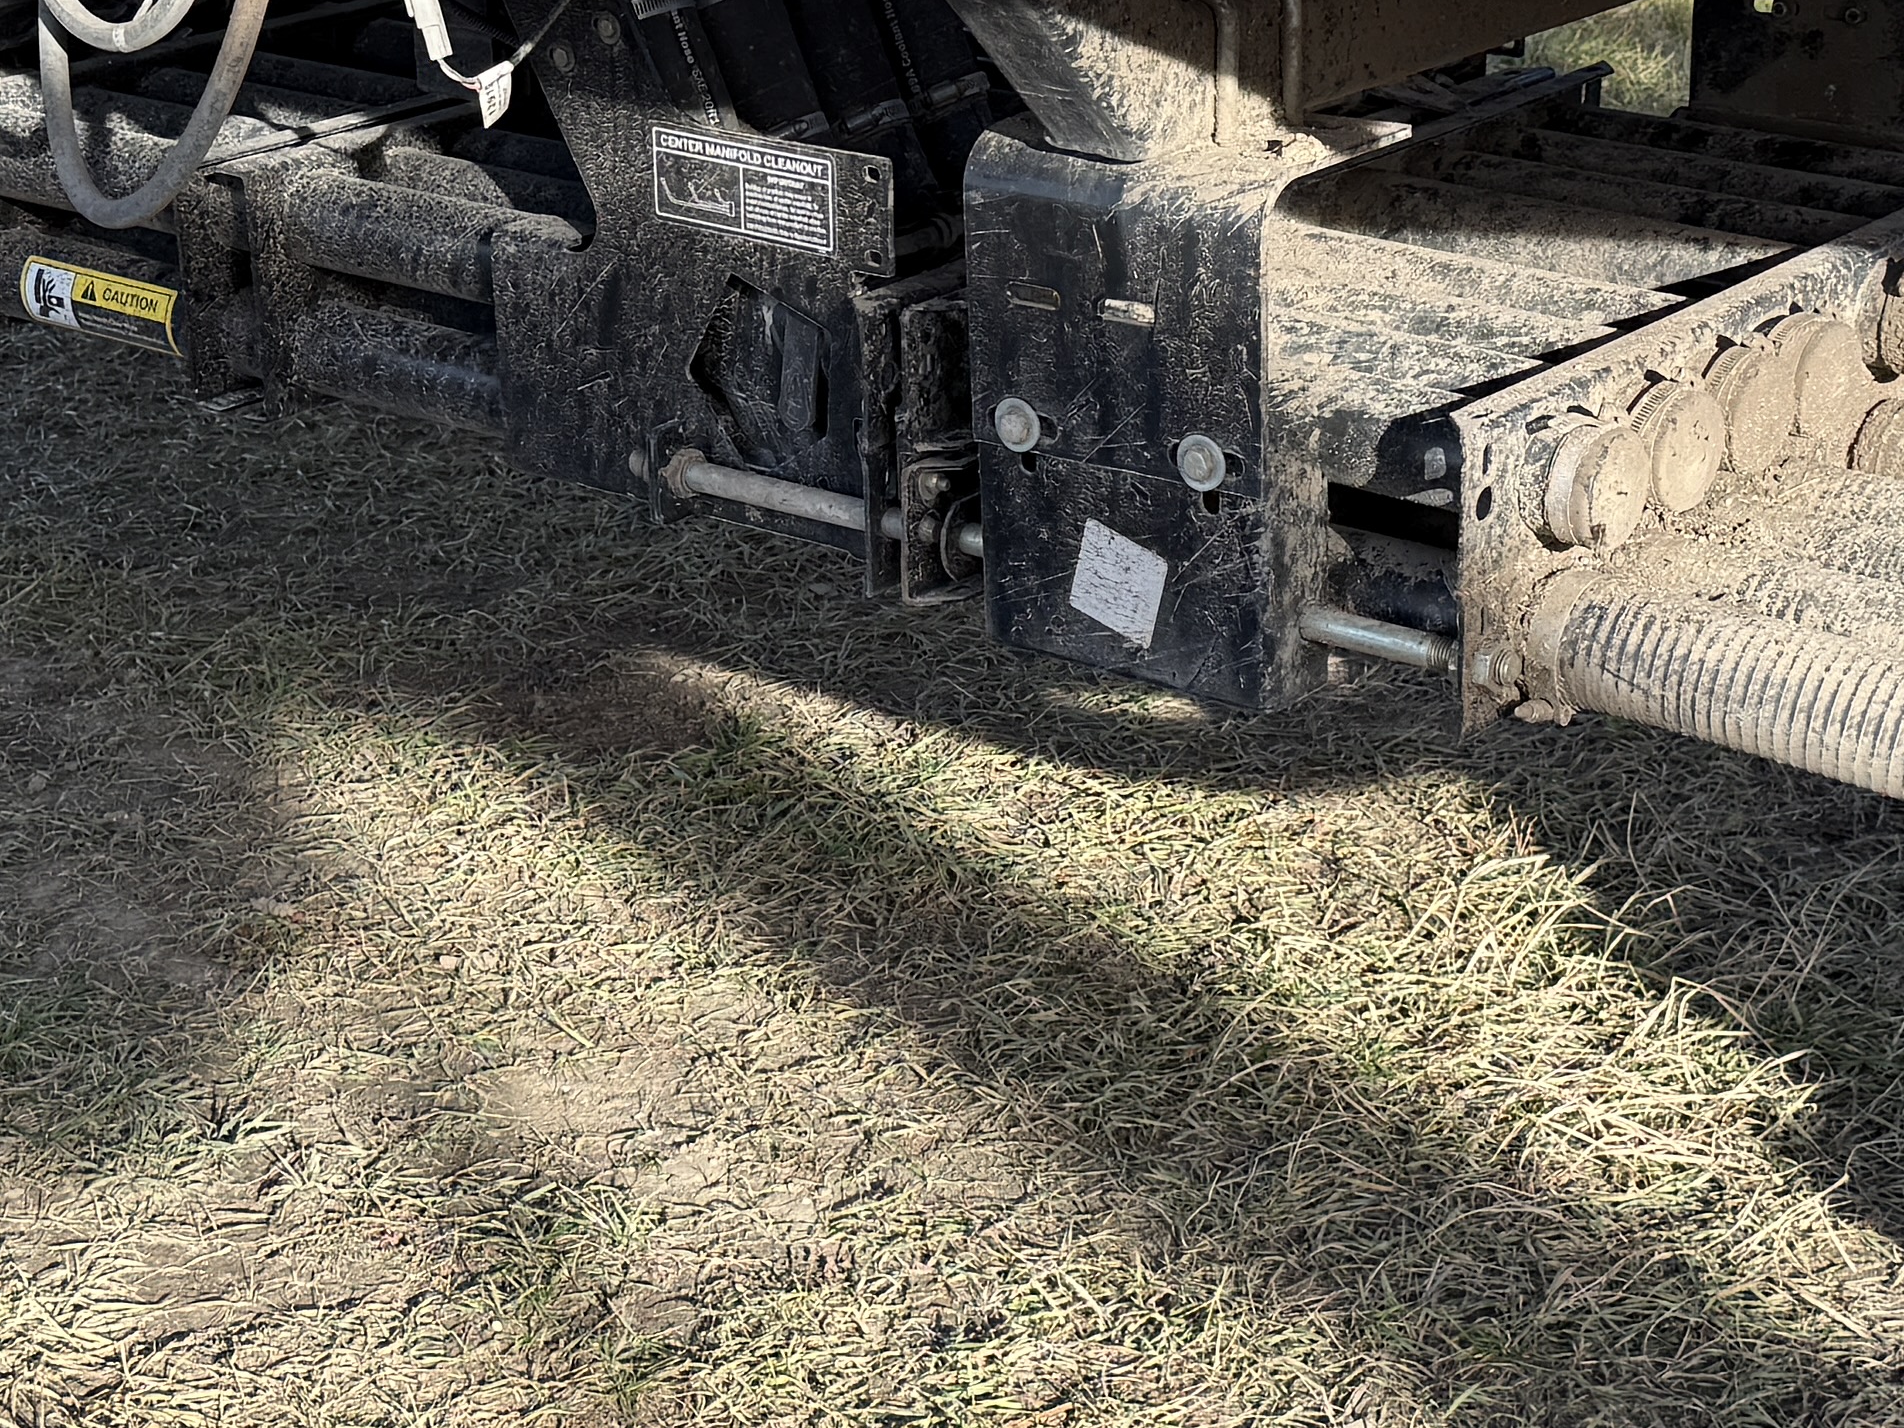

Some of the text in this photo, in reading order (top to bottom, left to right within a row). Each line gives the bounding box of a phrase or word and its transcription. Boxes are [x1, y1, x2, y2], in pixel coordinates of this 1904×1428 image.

[677, 31, 695, 64] Hose
[691, 68, 709, 93] SAE
[889, 19, 912, 68] Coolant
[659, 133, 824, 177] CENTER MANIFOLD CLEANOUT
[102, 287, 159, 313] CAUTION
